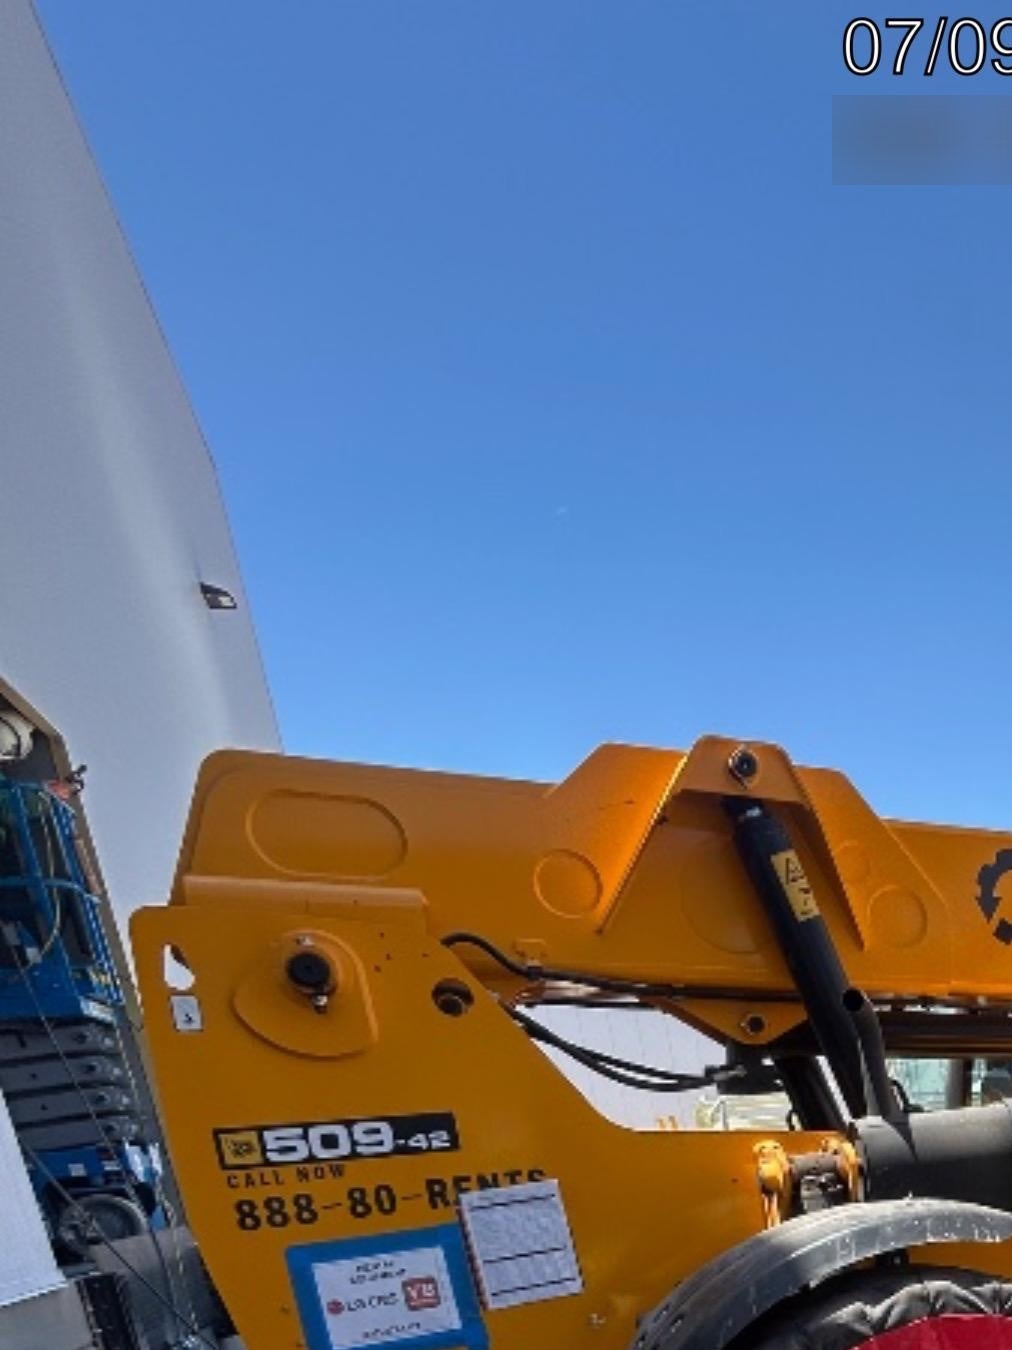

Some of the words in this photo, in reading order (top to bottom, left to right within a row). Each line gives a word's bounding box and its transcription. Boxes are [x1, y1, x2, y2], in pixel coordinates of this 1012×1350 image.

[262, 1121, 450, 1162] 509-42
[227, 1169, 285, 1189] CALL
[296, 1164, 345, 1183] NOW
